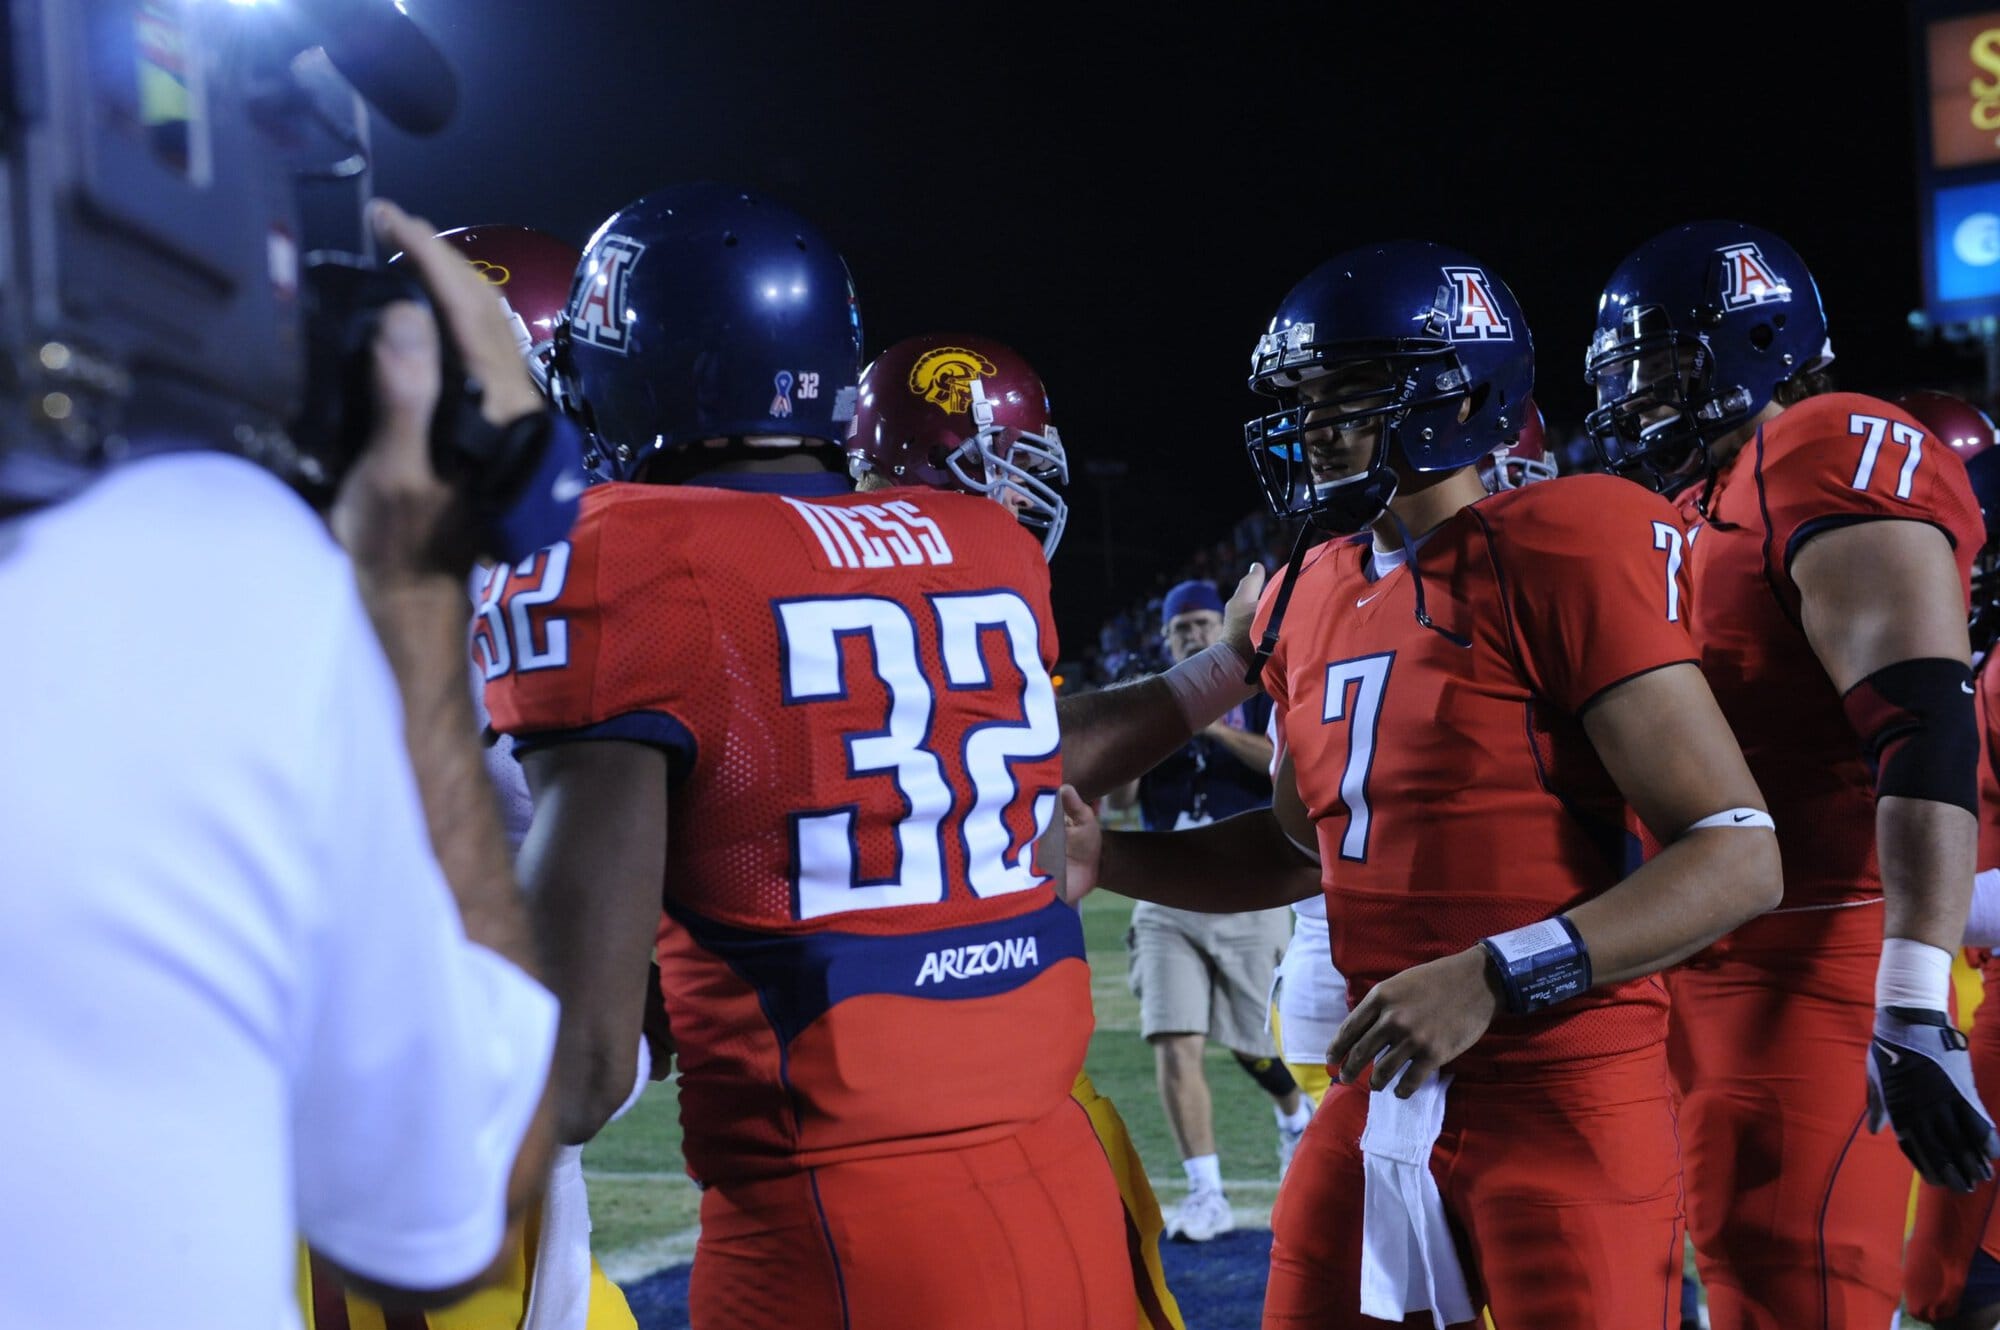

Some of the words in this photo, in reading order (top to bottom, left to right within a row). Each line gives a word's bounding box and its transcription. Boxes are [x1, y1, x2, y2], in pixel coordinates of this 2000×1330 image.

[1441, 266, 1513, 341] A
[1716, 242, 1791, 312] A
[797, 372, 820, 399] 32
[1848, 413, 1925, 500] 77
[779, 495, 954, 569] NESS
[1651, 520, 1684, 623] 7
[476, 540, 572, 682] 32
[772, 589, 1061, 920] 32
[1322, 651, 1396, 862] 7
[914, 935, 1040, 988] ARIZONA
